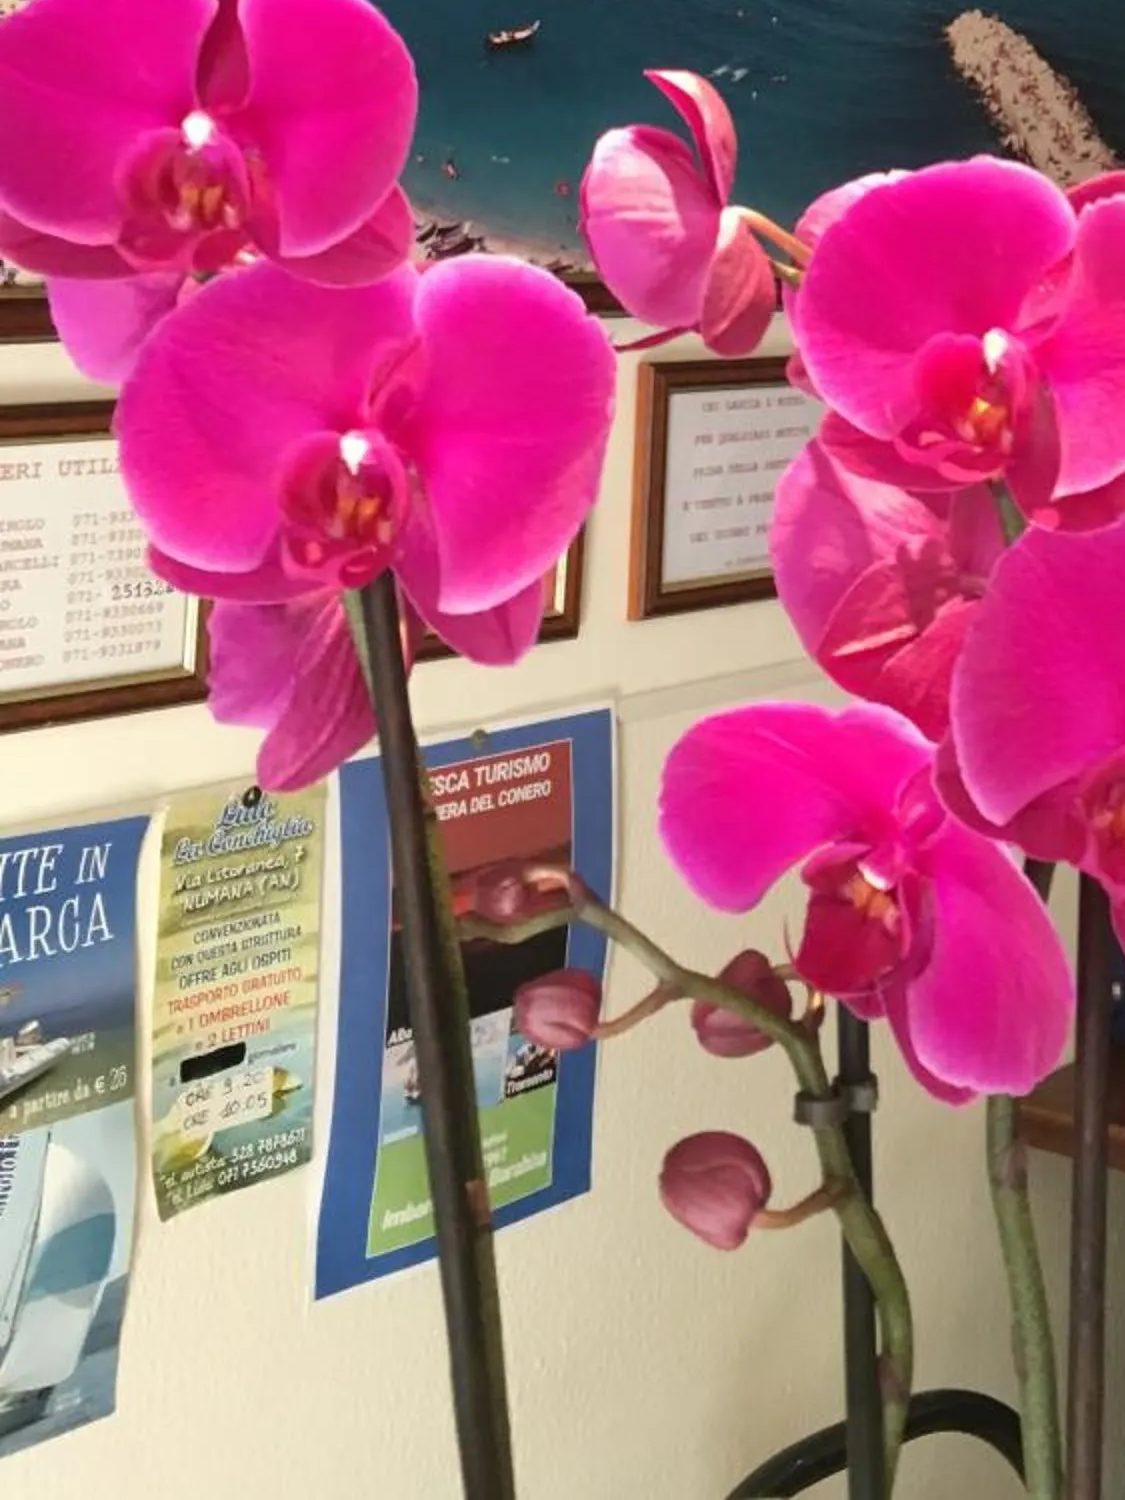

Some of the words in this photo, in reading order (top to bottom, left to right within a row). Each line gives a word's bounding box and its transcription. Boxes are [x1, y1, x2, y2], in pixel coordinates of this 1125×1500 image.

[474, 752, 551, 787] TURISMO
[469, 793, 496, 814] DEL
[498, 779, 552, 807] CONERO
[206, 815, 315, 858] Conchiglia
[74, 842, 112, 885] IN
[174, 873, 202, 894] Via
[182, 881, 254, 913] NUMANA
[258, 868, 301, 897] (AN)
[193, 911, 282, 946] CONVENZIONATA
[171, 953, 195, 972] CON
[197, 941, 238, 964] QUESTA
[179, 966, 217, 991] OFFRE
[221, 959, 249, 978] AGLI
[251, 948, 292, 970] OSPITI
[168, 982, 240, 1014] TRASPORTO
[242, 966, 303, 996] GRATUITO
[200, 990, 291, 1028] OMBRELLONE
[221, 1017, 272, 1044] LETTINI
[22, 1089, 71, 1125] partire
[73, 1077, 90, 1102] da
